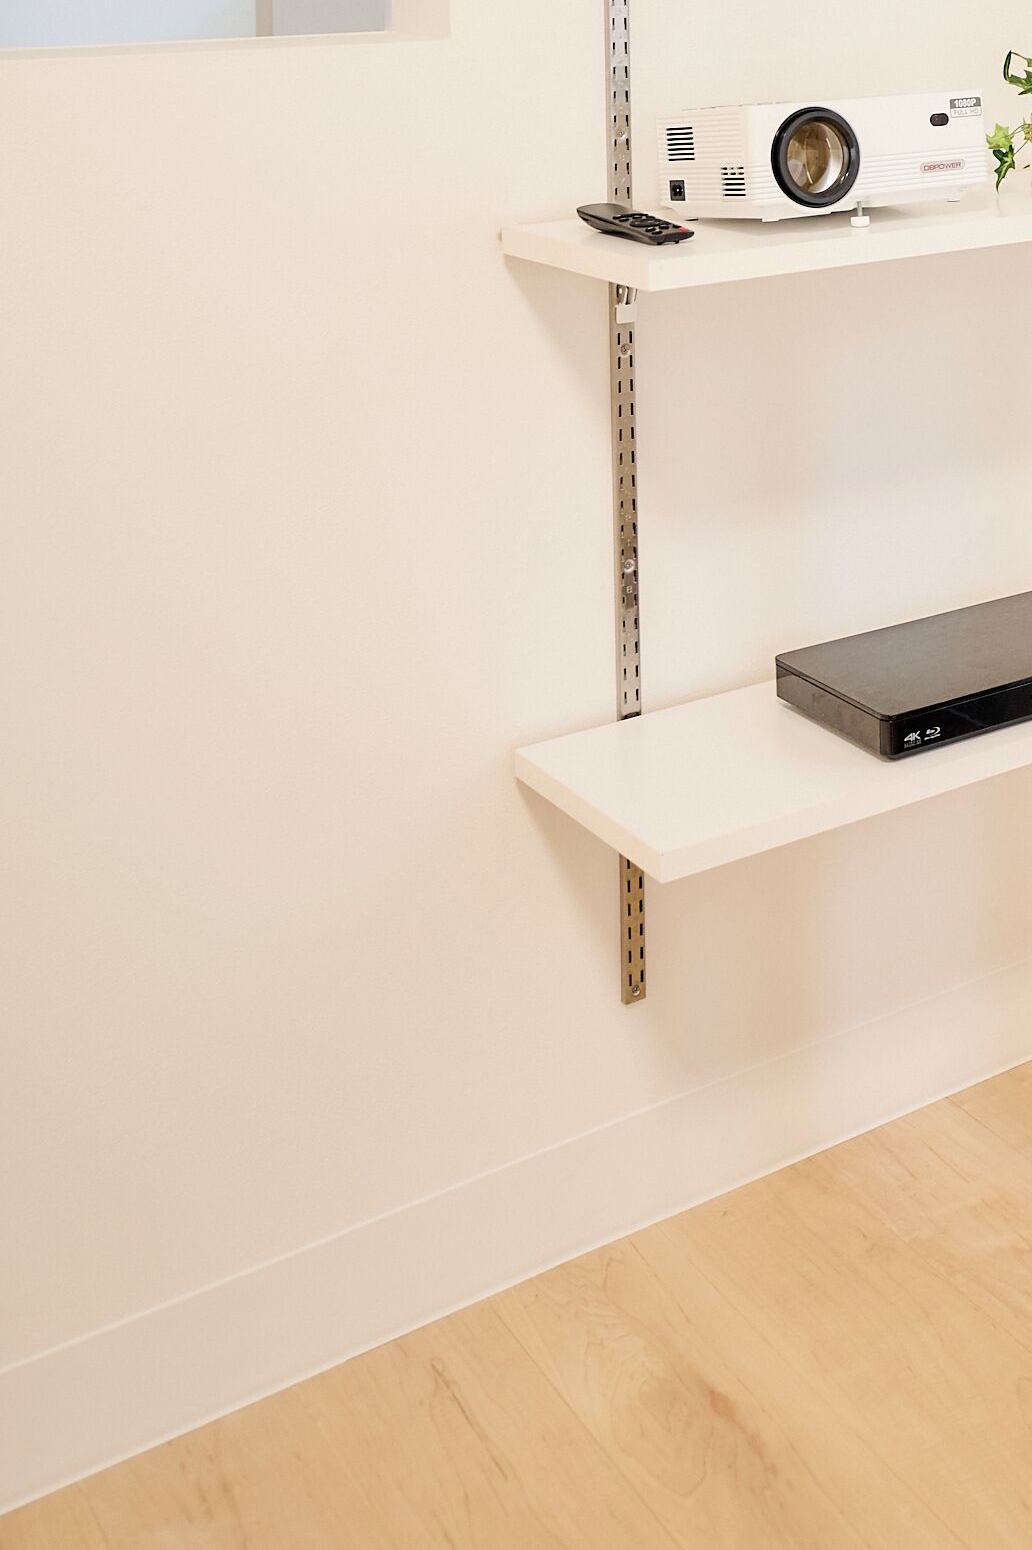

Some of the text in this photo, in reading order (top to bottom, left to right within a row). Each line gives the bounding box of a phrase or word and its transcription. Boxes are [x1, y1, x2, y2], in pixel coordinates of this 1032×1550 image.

[954, 99, 977, 108] 1080P
[923, 162, 961, 171] DBPOWER
[904, 731, 921, 741] 4K
